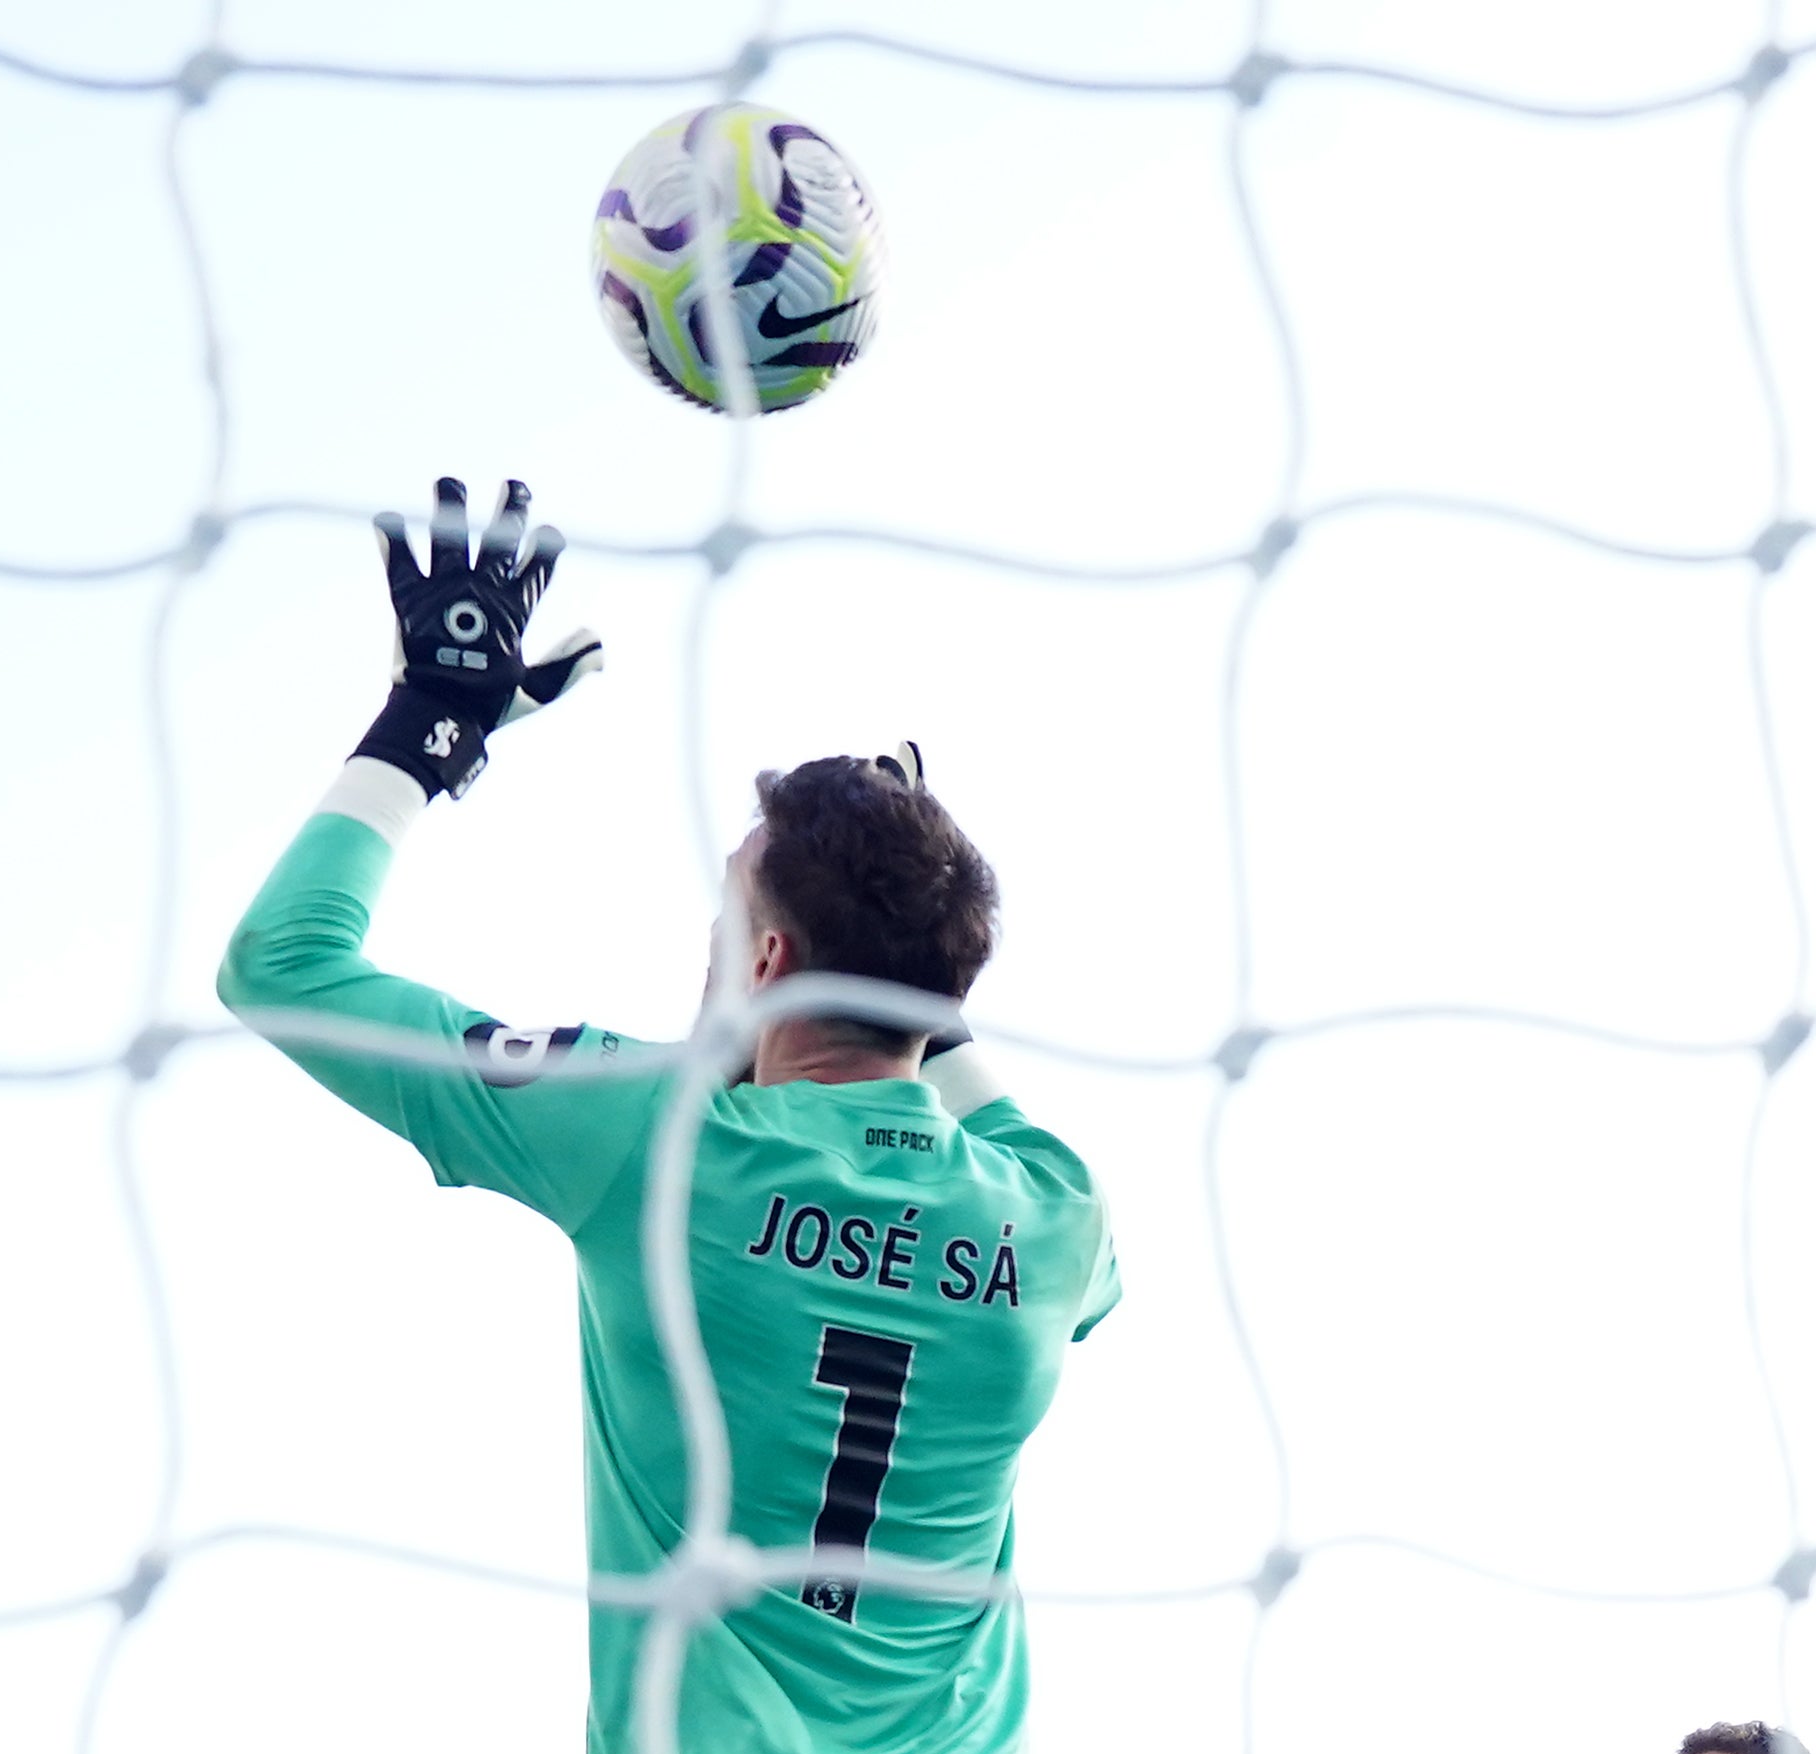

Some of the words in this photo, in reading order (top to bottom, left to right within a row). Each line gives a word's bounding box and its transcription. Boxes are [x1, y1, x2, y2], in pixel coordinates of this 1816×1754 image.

[866, 1127, 897, 1148] ONE
[900, 1130, 934, 1154] PACK
[748, 1192, 923, 1292] JOSÉ
[938, 1222, 1021, 1309] SÁ
[800, 1322, 916, 1627] 1
